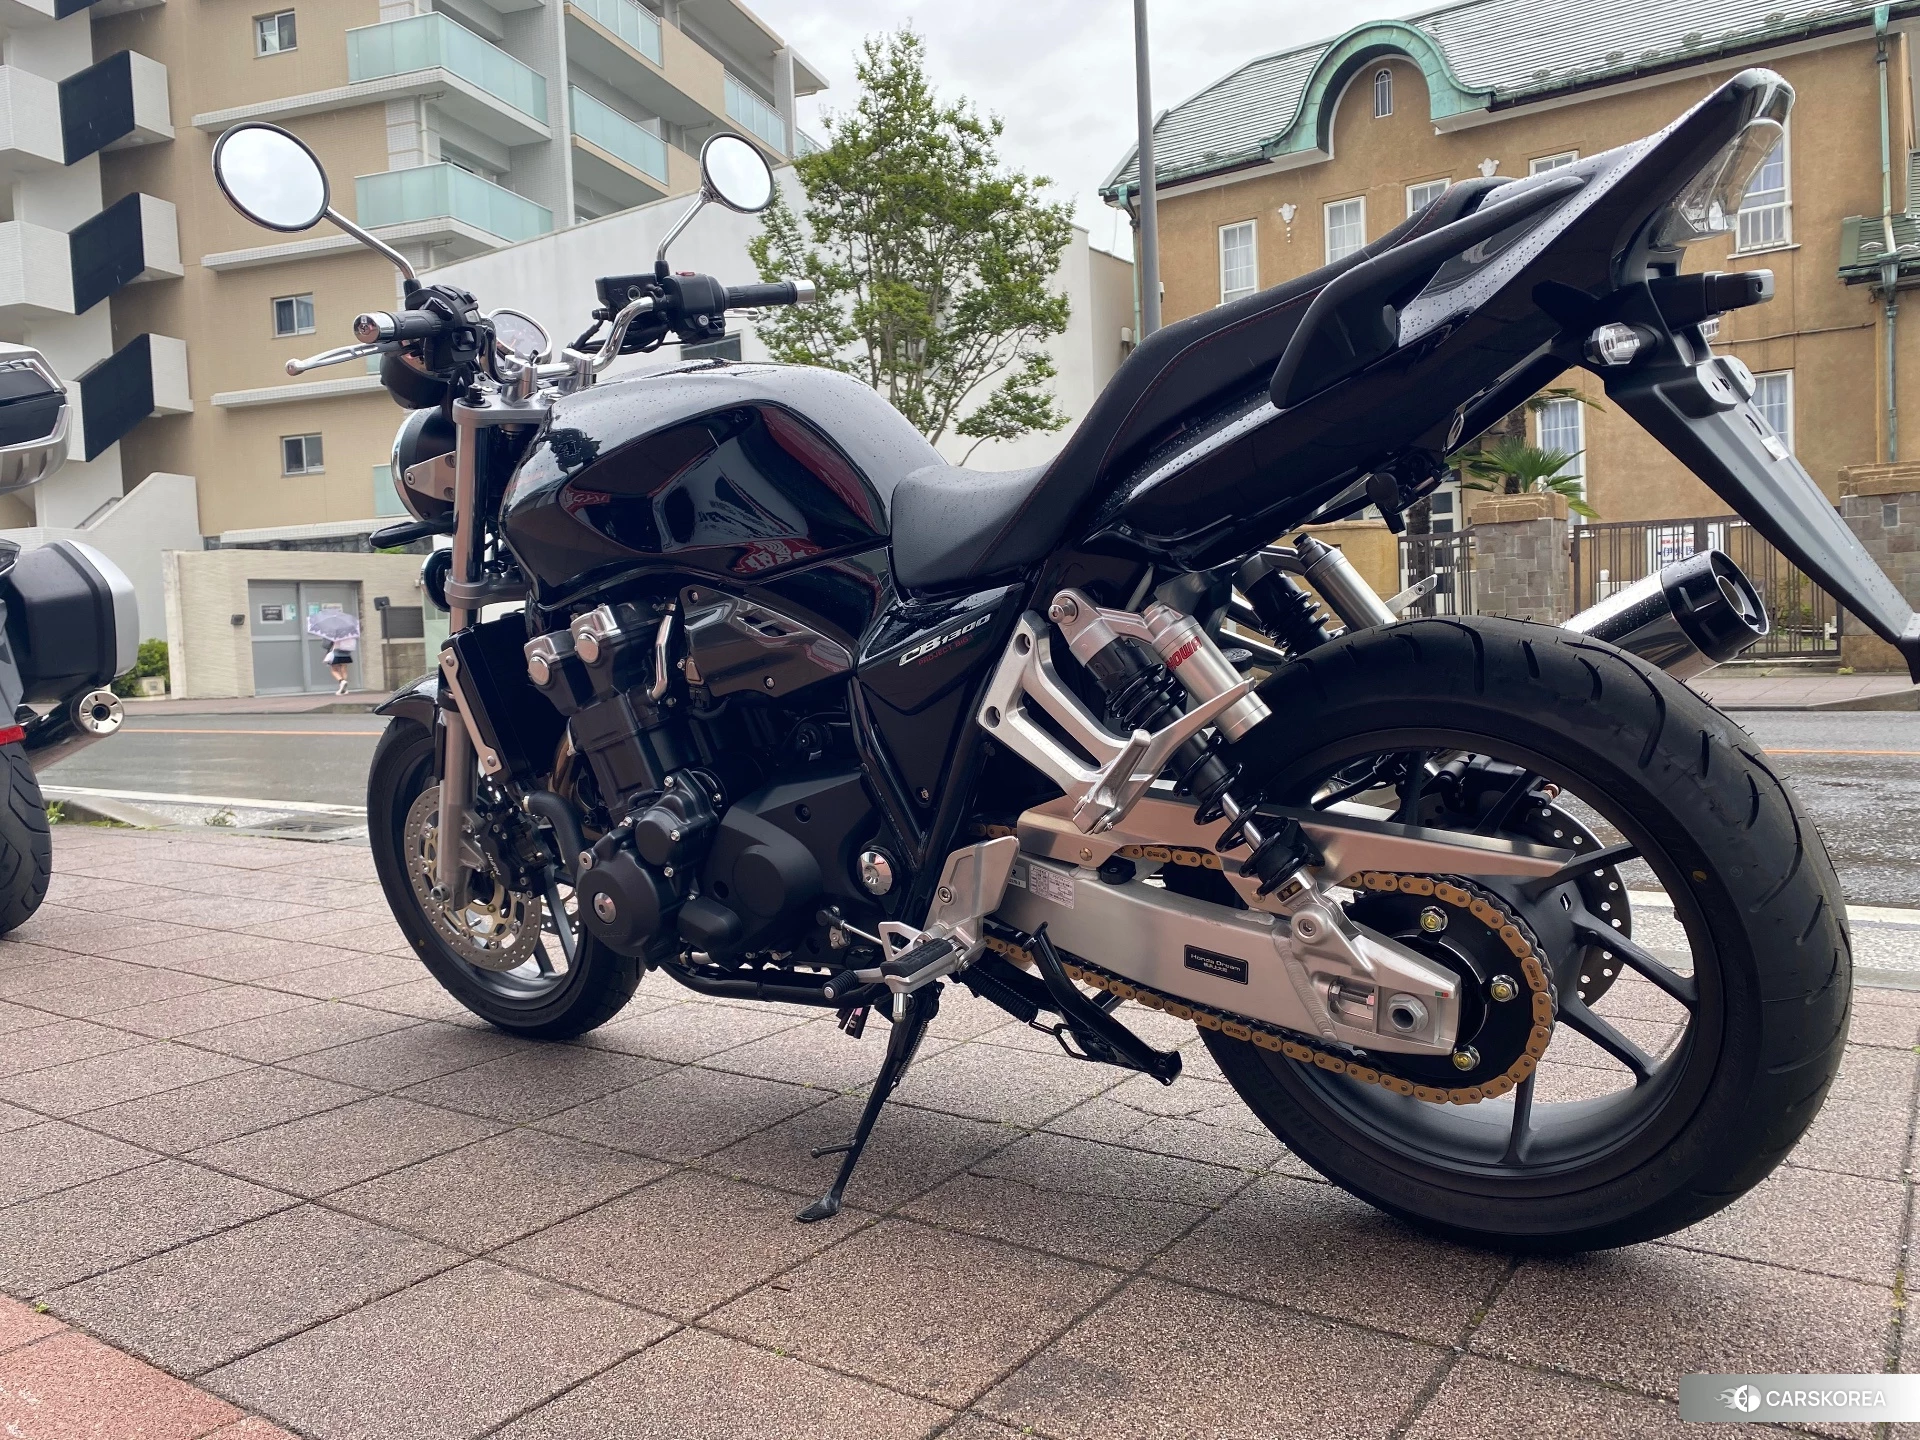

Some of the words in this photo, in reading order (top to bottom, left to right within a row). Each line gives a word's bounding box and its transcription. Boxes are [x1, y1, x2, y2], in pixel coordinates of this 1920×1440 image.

[899, 613, 991, 667] CB1300
[1190, 954, 1215, 965] Honda
[1215, 960, 1241, 971] Dream
